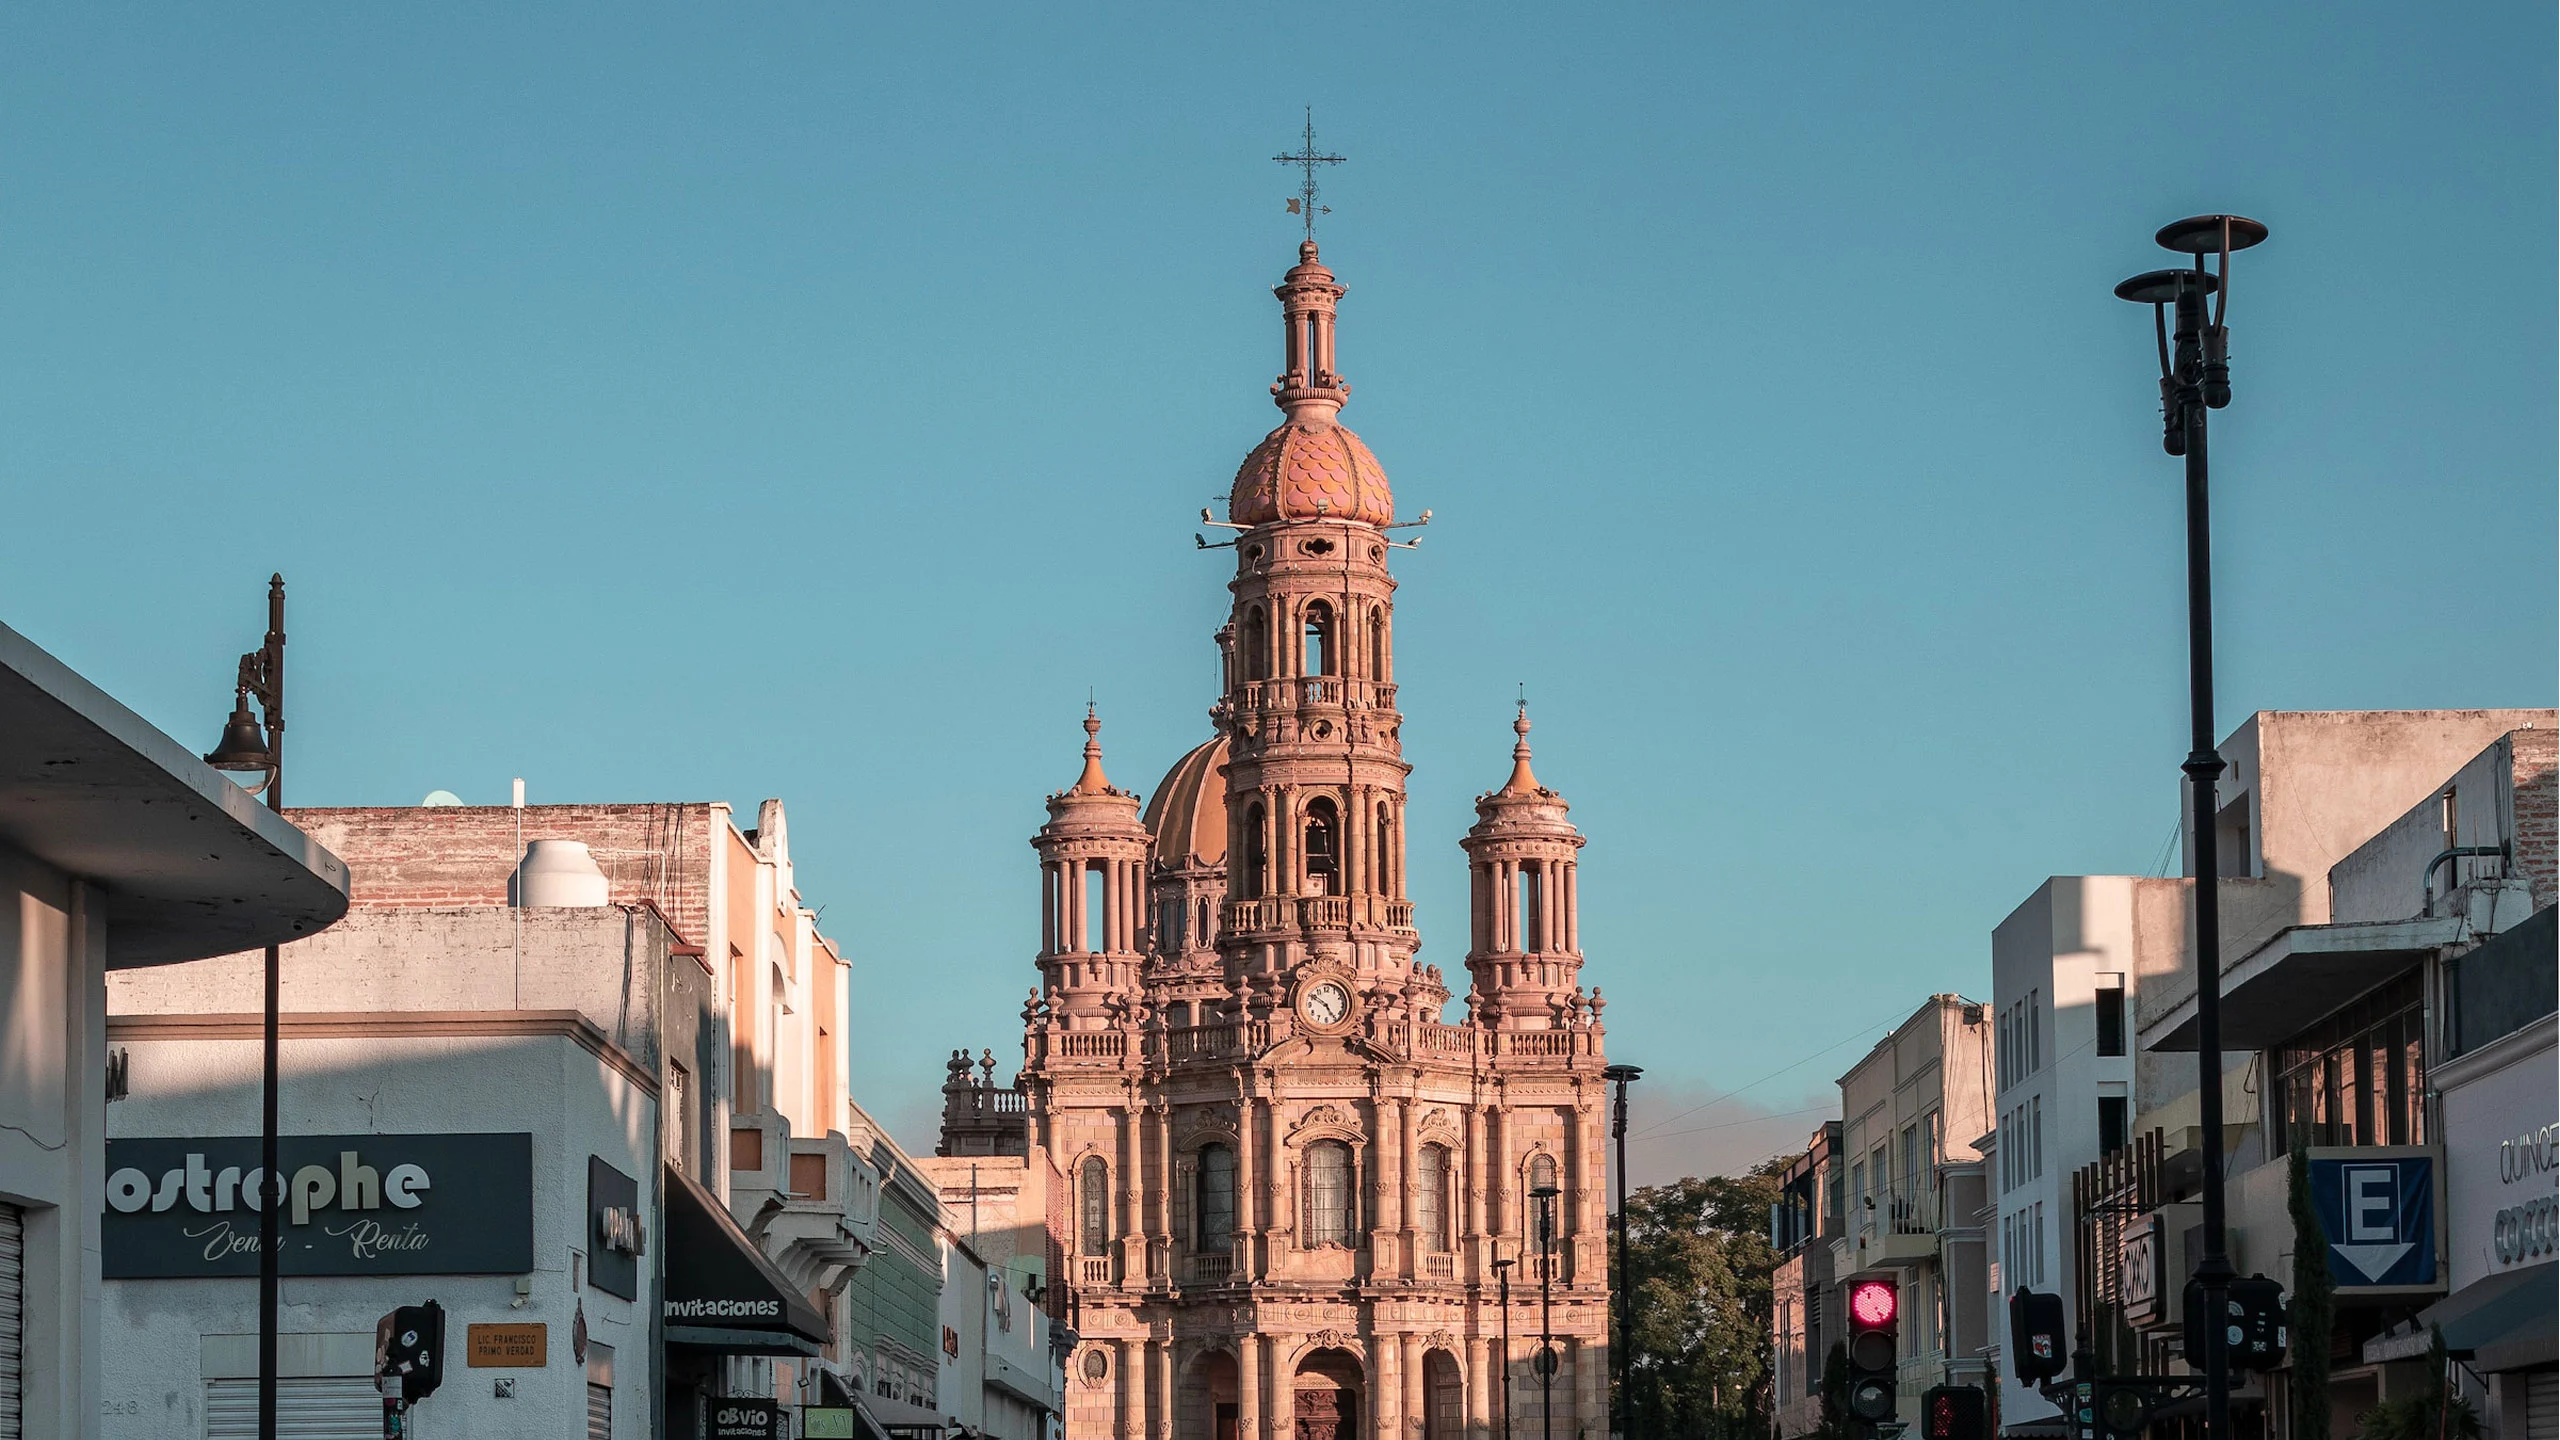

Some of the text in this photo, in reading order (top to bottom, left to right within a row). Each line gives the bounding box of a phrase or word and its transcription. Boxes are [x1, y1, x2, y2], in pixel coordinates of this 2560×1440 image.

[2350, 1169, 2394, 1240] E
[324, 1219, 430, 1259] Renta
[478, 1346, 535, 1356] PRIMO VERDAD
[494, 1335, 537, 1345] FRANCISCO
